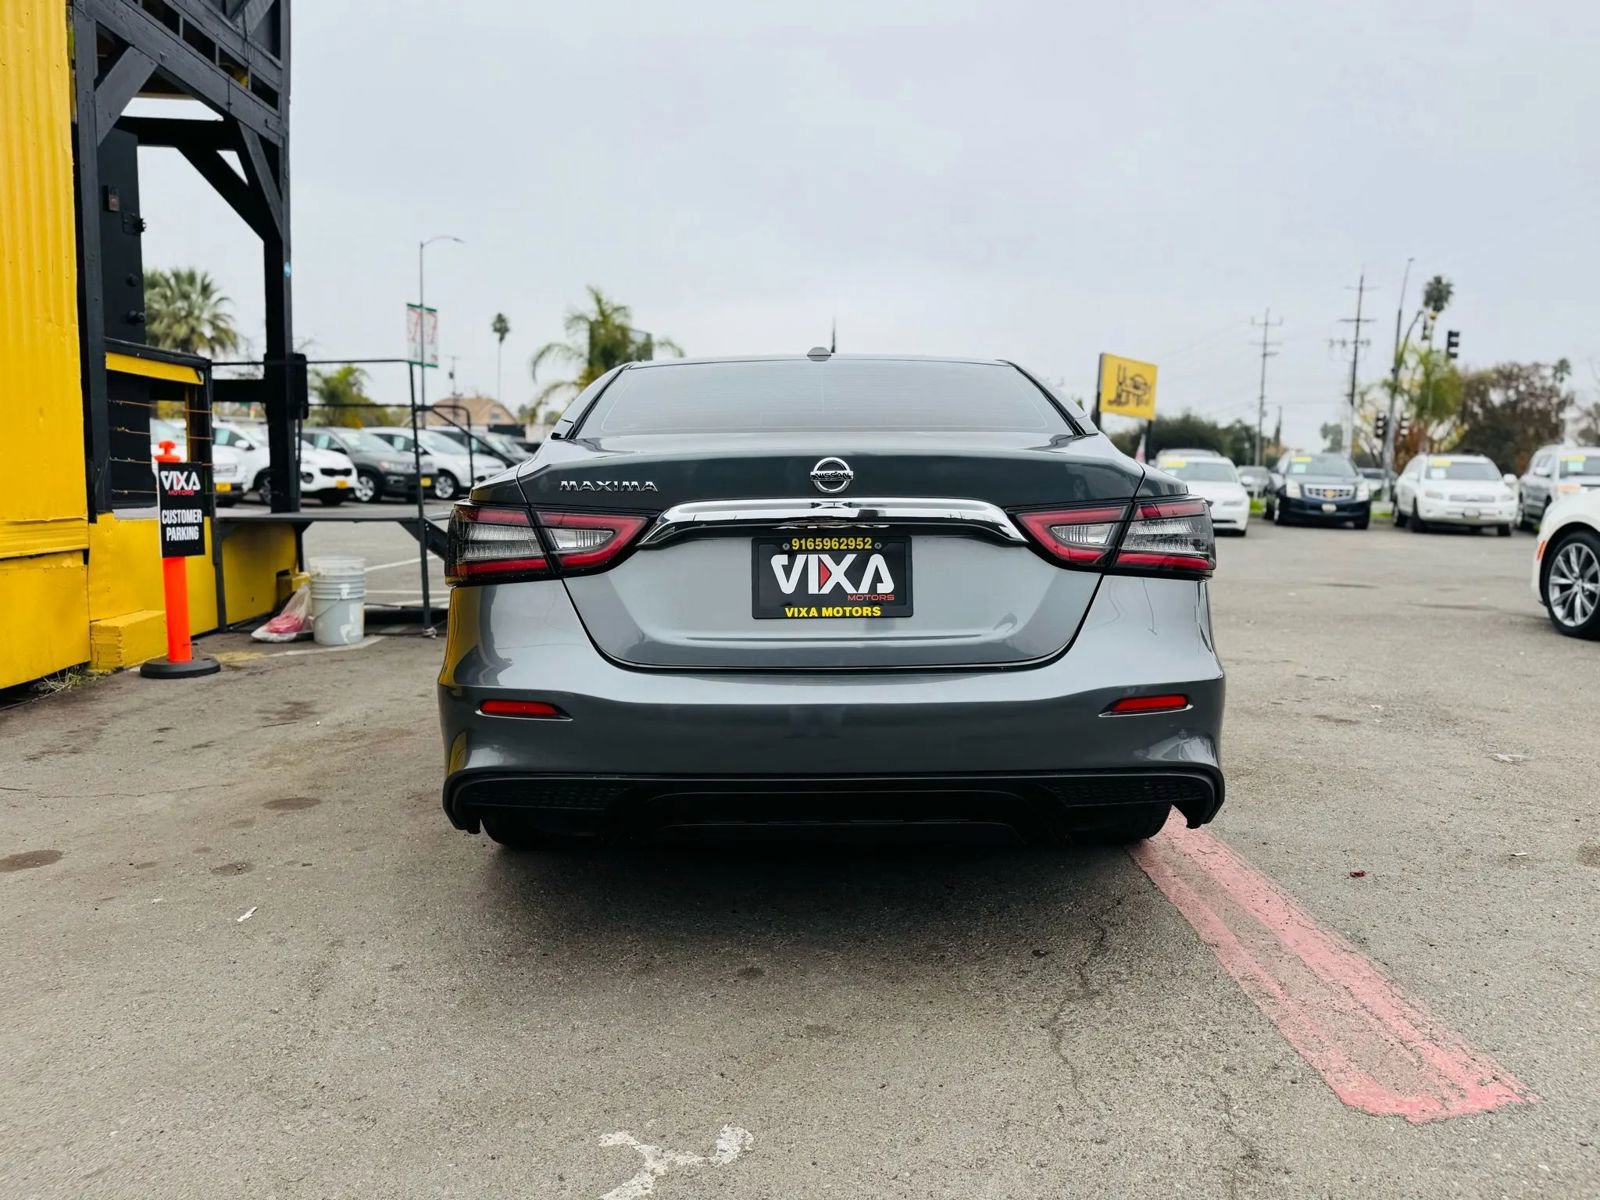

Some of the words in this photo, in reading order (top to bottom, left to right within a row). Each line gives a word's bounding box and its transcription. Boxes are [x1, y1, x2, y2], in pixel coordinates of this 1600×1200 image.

[160, 470, 201, 491] VIXA
[813, 471, 852, 480] NISSAN
[560, 480, 658, 492] MAXIMA
[161, 509, 203, 524] CUSTOMER
[166, 526, 199, 541] PARKING
[791, 537, 872, 550] 9165962952
[770, 553, 895, 594] VIXA
[785, 607, 818, 617] VIXA
[821, 606, 881, 617] MOTORS
